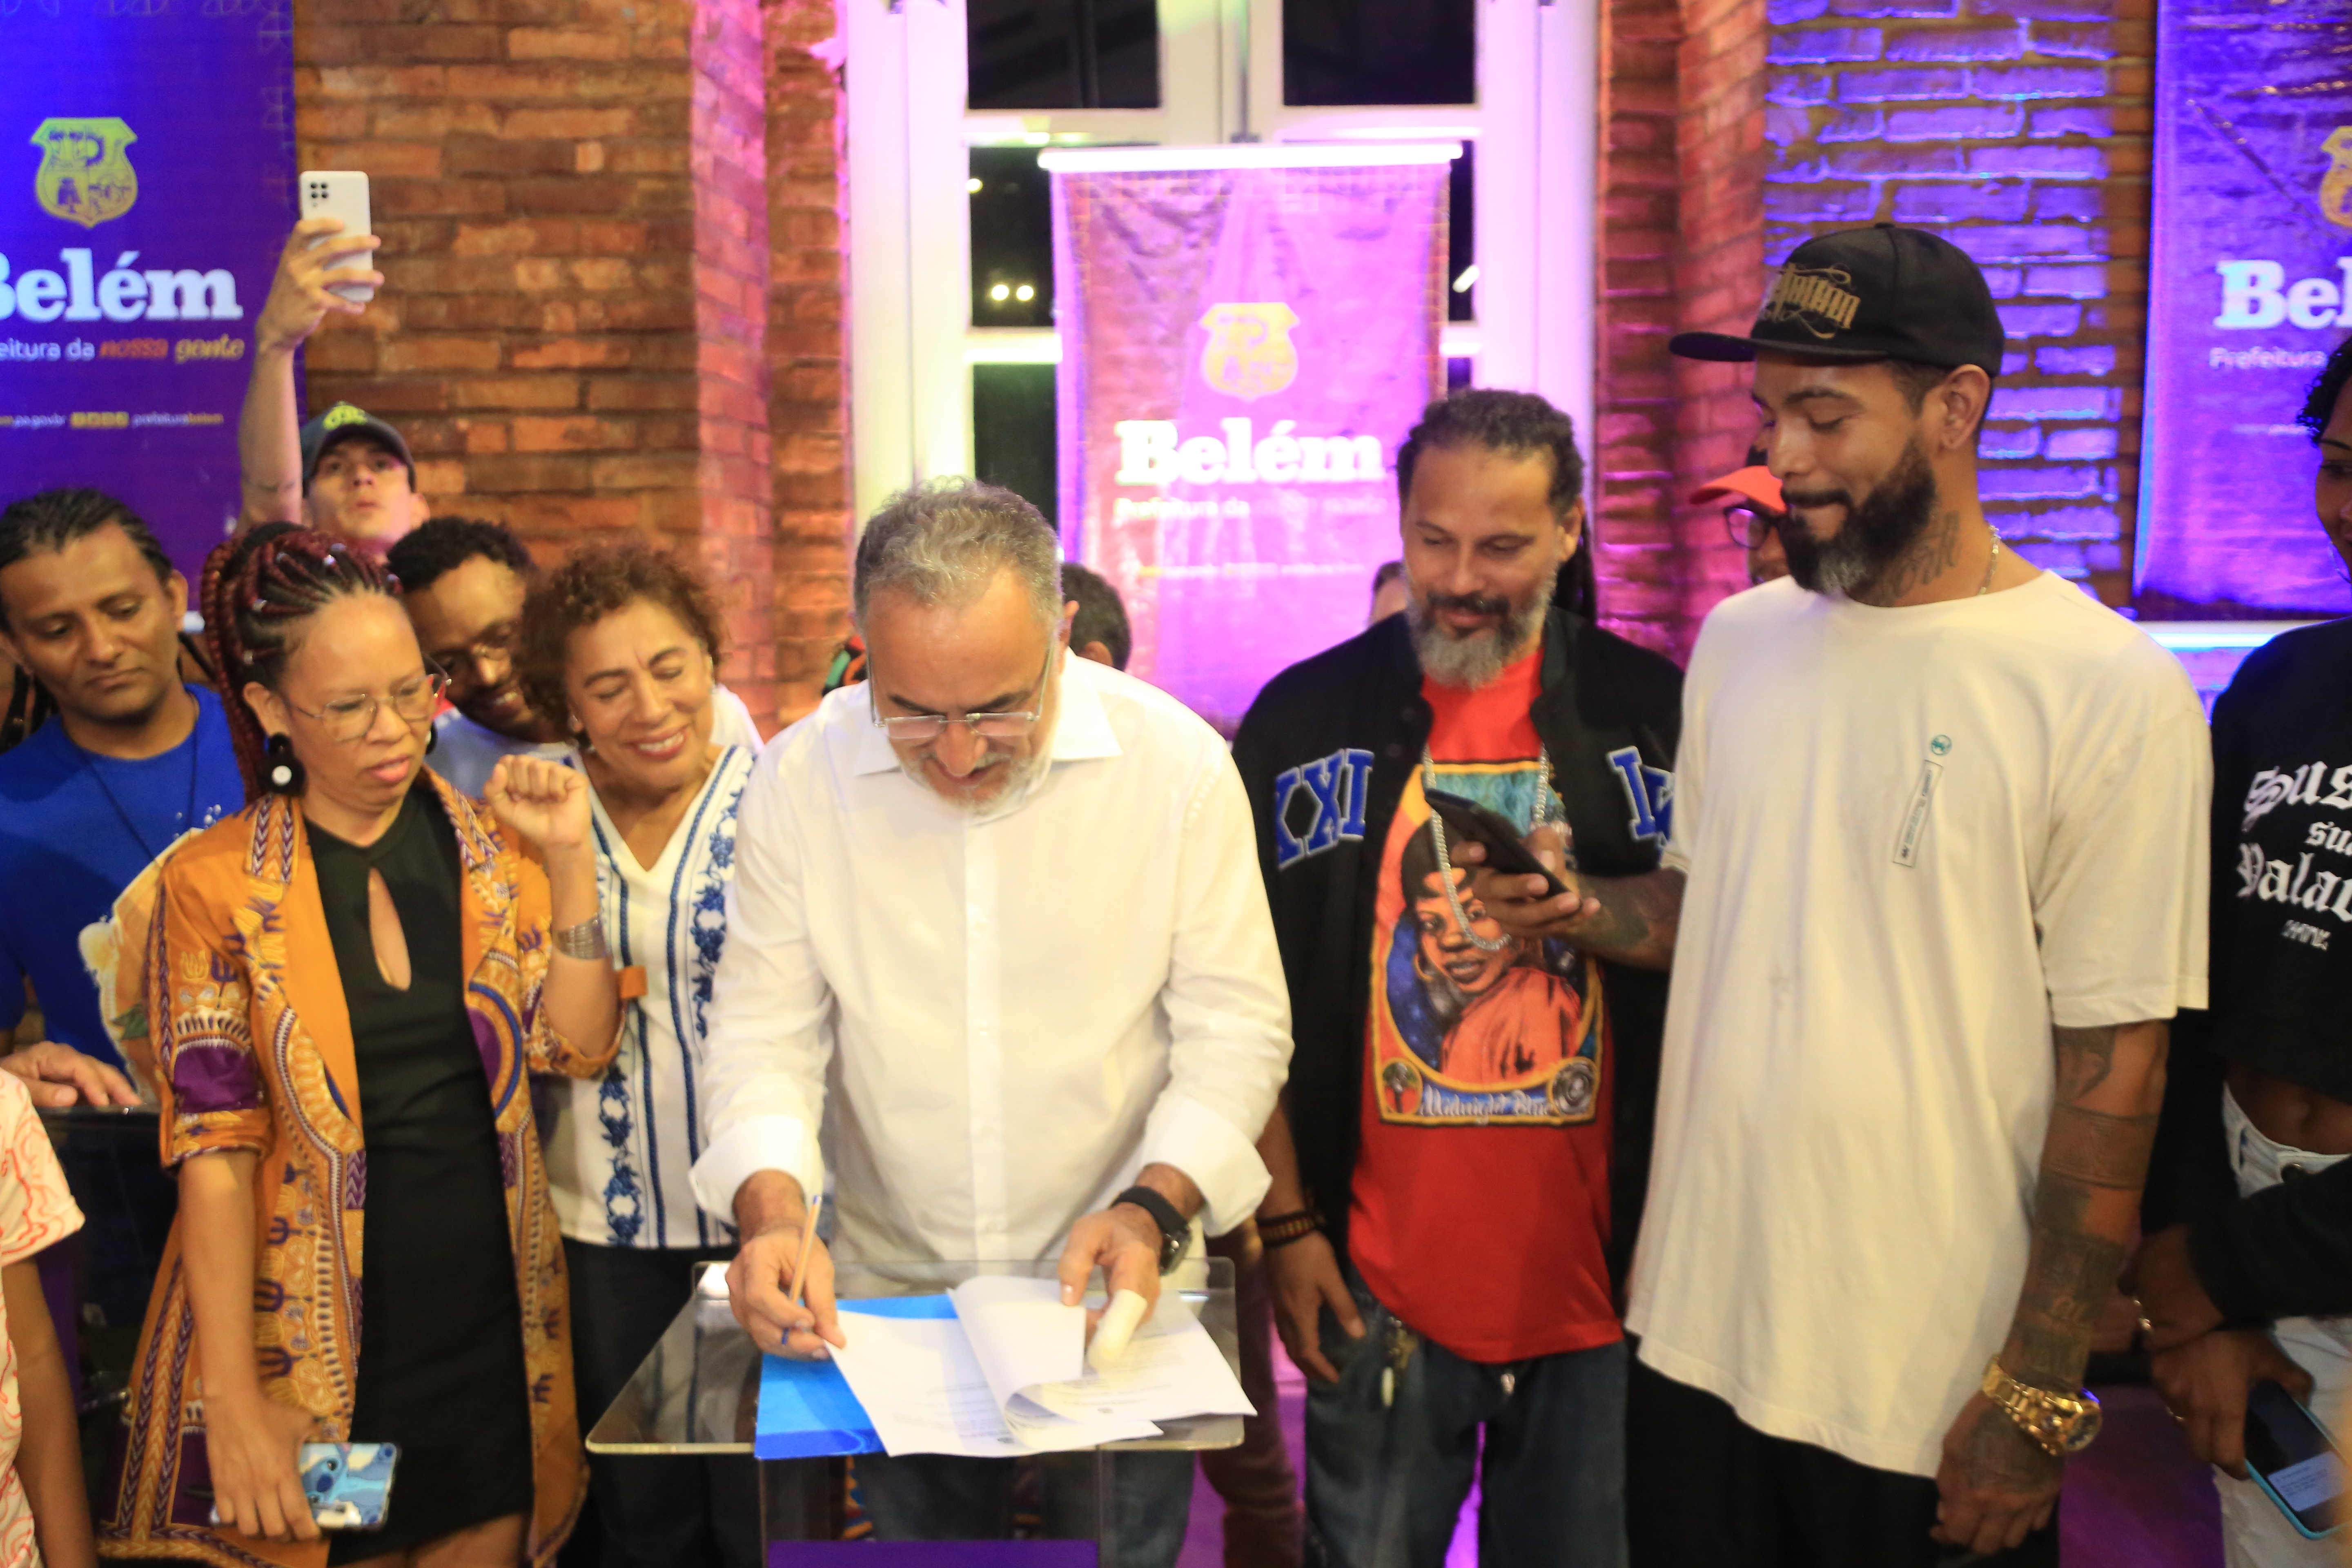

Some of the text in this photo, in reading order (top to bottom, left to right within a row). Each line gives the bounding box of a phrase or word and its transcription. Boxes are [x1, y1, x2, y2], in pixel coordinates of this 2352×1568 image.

[0, 247, 244, 322] elém
[65, 337, 96, 362] da
[1114, 416, 1387, 486] Belém
[2304, 820, 2352, 857] su
